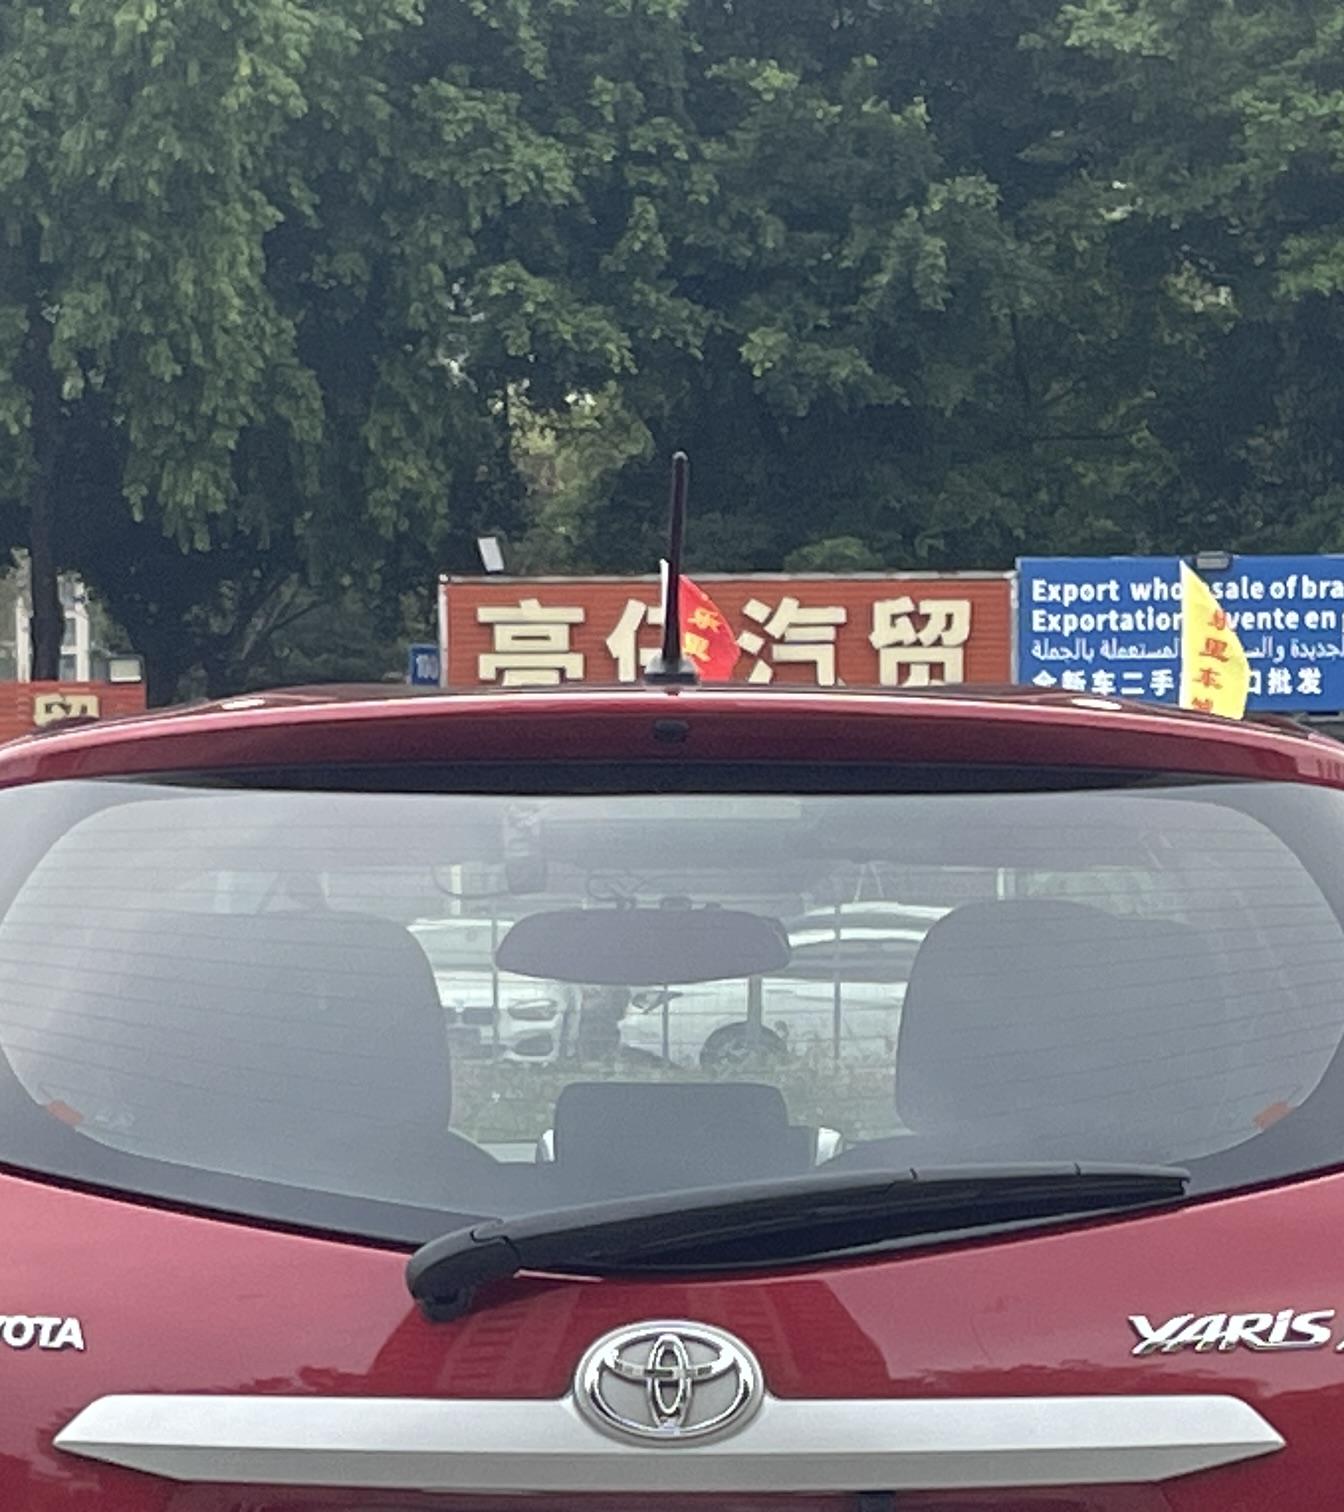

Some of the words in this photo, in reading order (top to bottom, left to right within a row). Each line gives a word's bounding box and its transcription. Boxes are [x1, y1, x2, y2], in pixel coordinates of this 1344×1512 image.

[1032, 578, 1120, 607] Export
[1130, 575, 1264, 601] whosale
[1269, 574, 1298, 600] of
[1224, 607, 1299, 630] vente
[1304, 608, 1337, 629] en
[1031, 637, 1095, 664] بالجملة
[1100, 636, 1180, 661] لمستعملة
[1127, 1308, 1336, 1355] YARIS
